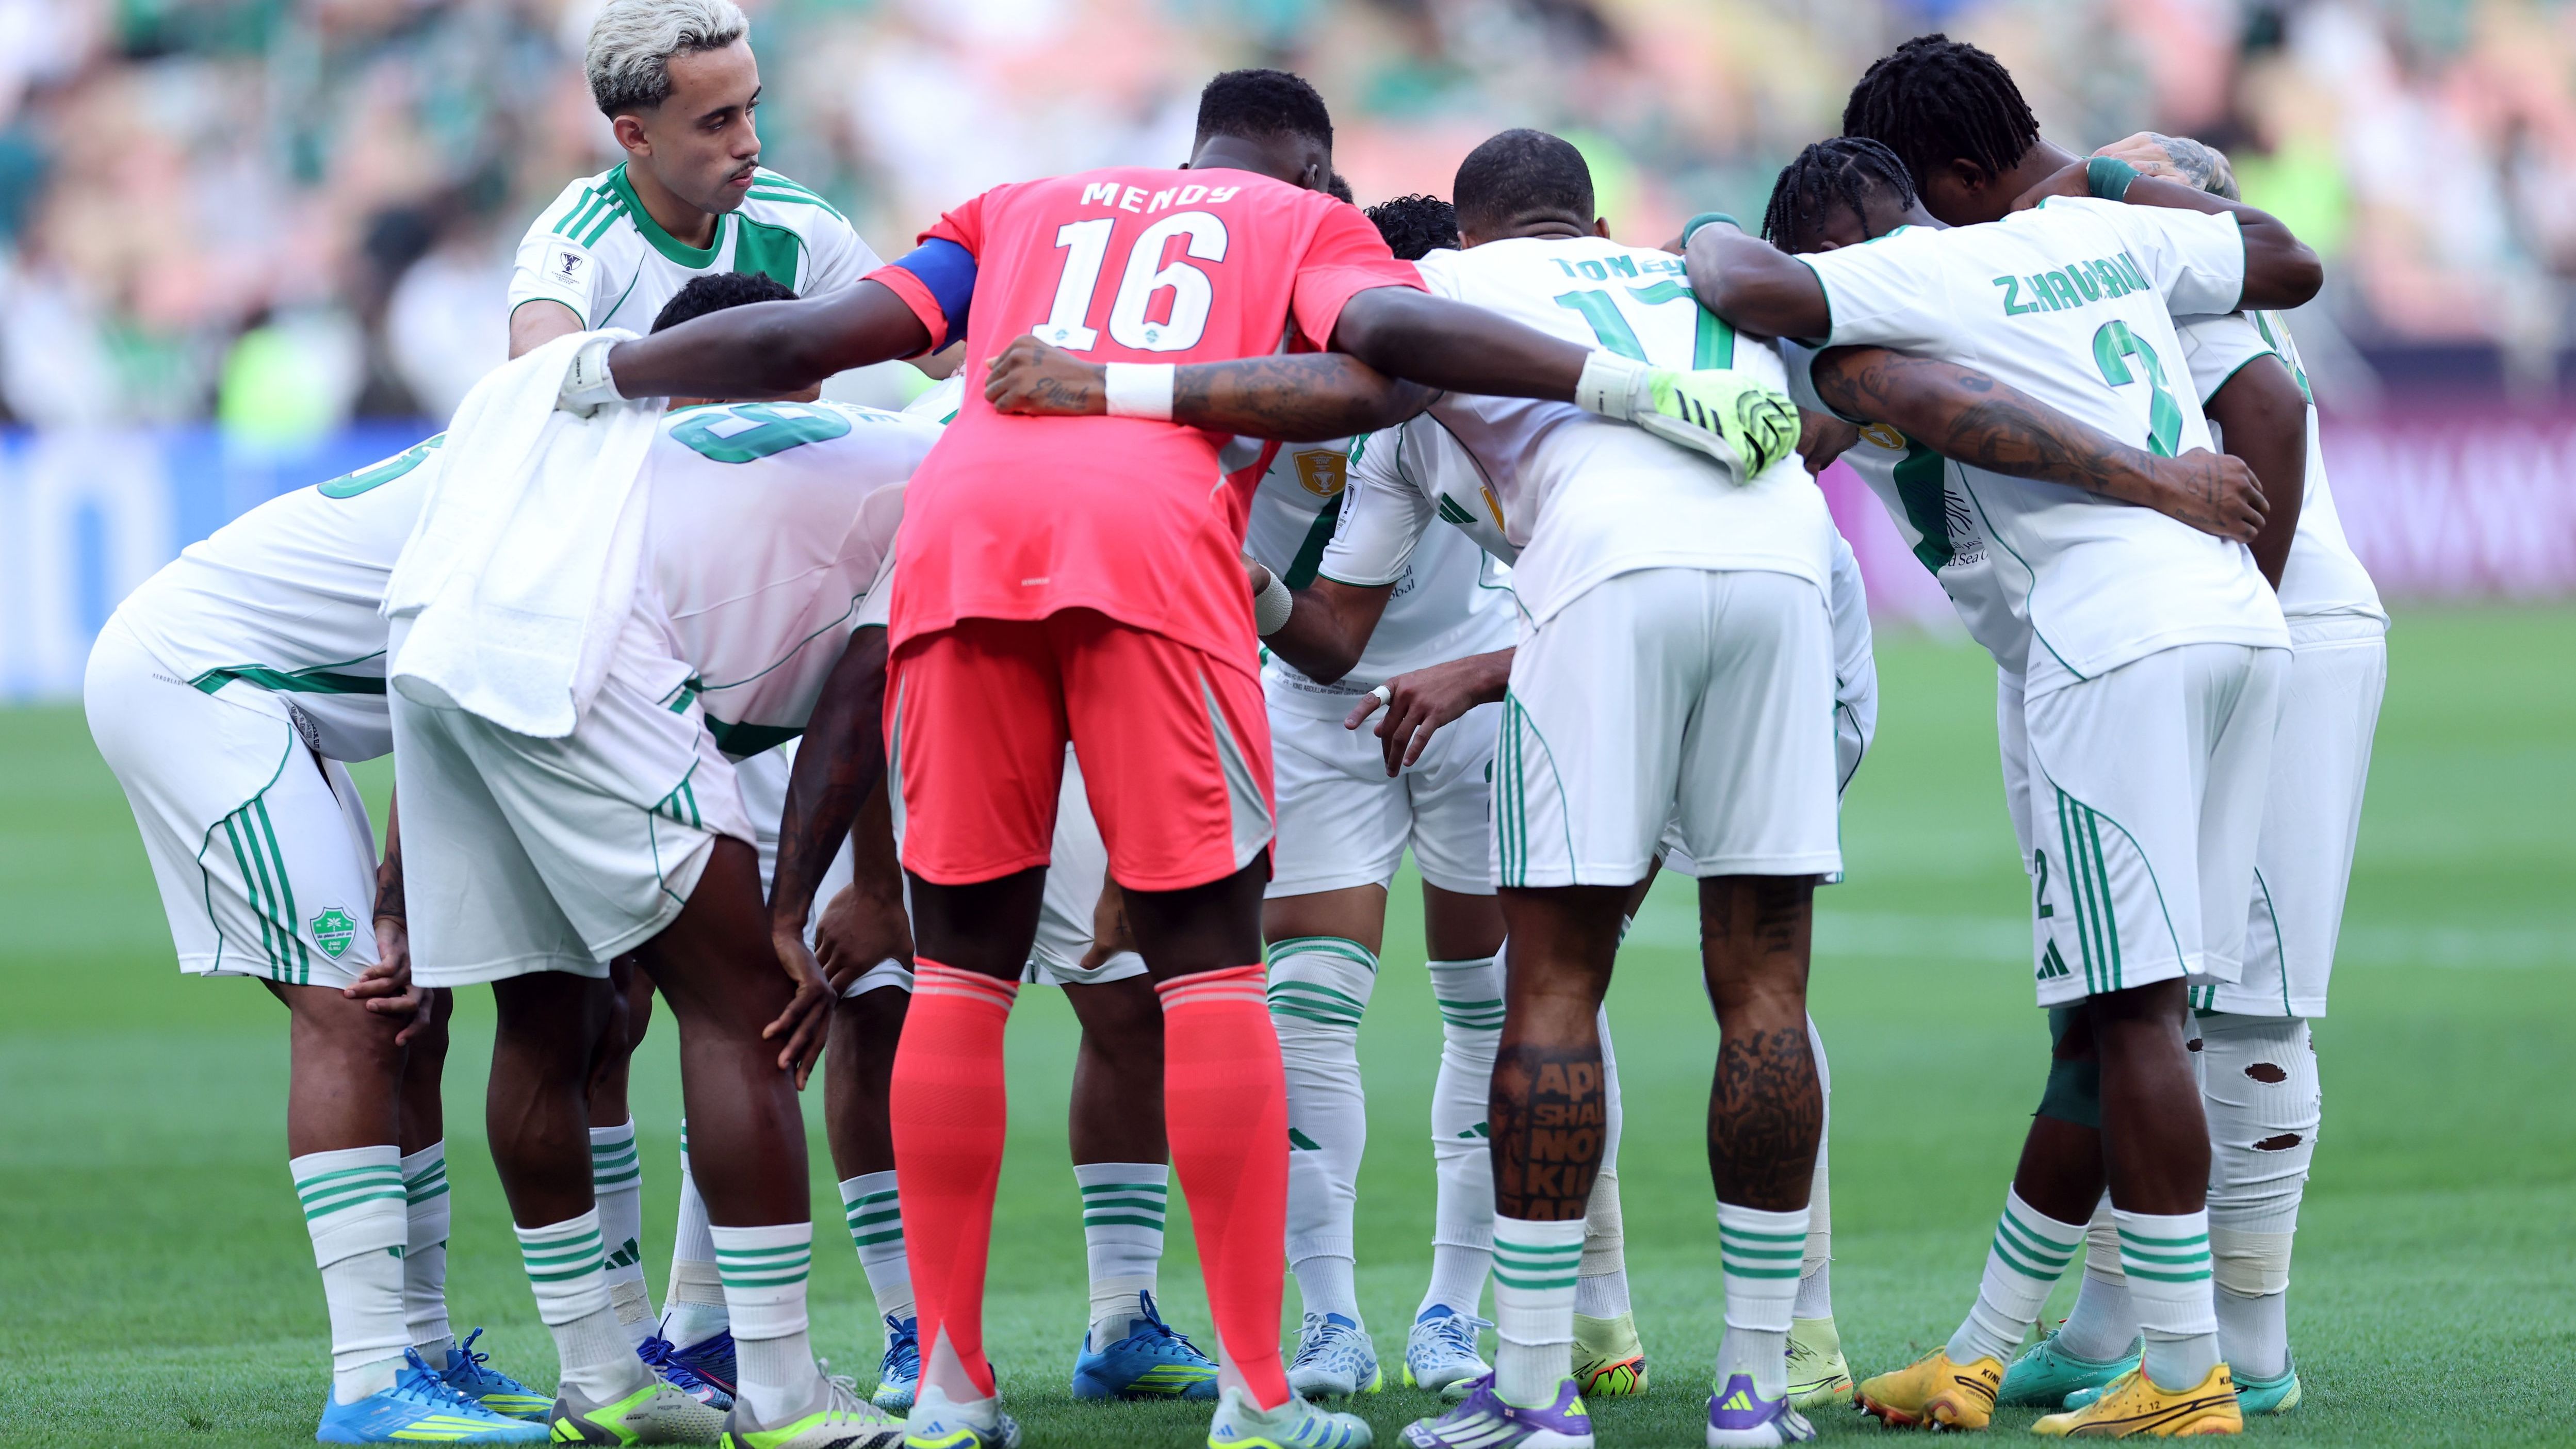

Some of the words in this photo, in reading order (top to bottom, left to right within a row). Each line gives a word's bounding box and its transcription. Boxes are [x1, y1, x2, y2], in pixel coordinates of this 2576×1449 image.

[1080, 182, 1242, 214] MENDY
[1031, 210, 1229, 352] 16
[1548, 255, 1687, 281] TONEY
[1554, 280, 1735, 370] 17
[2092, 320, 2182, 458] 2
[1958, 552, 1979, 566] Sea
[1389, 578, 1415, 601] obal
[152, 673, 184, 686] AEROREADY
[2034, 848, 2054, 920] 2
[1530, 1127, 1605, 1164] NO
[1526, 1164, 1591, 1197] KIL
[2072, 1371, 2098, 1382] ULTRA
[1405, 1426, 1437, 1449] 50
